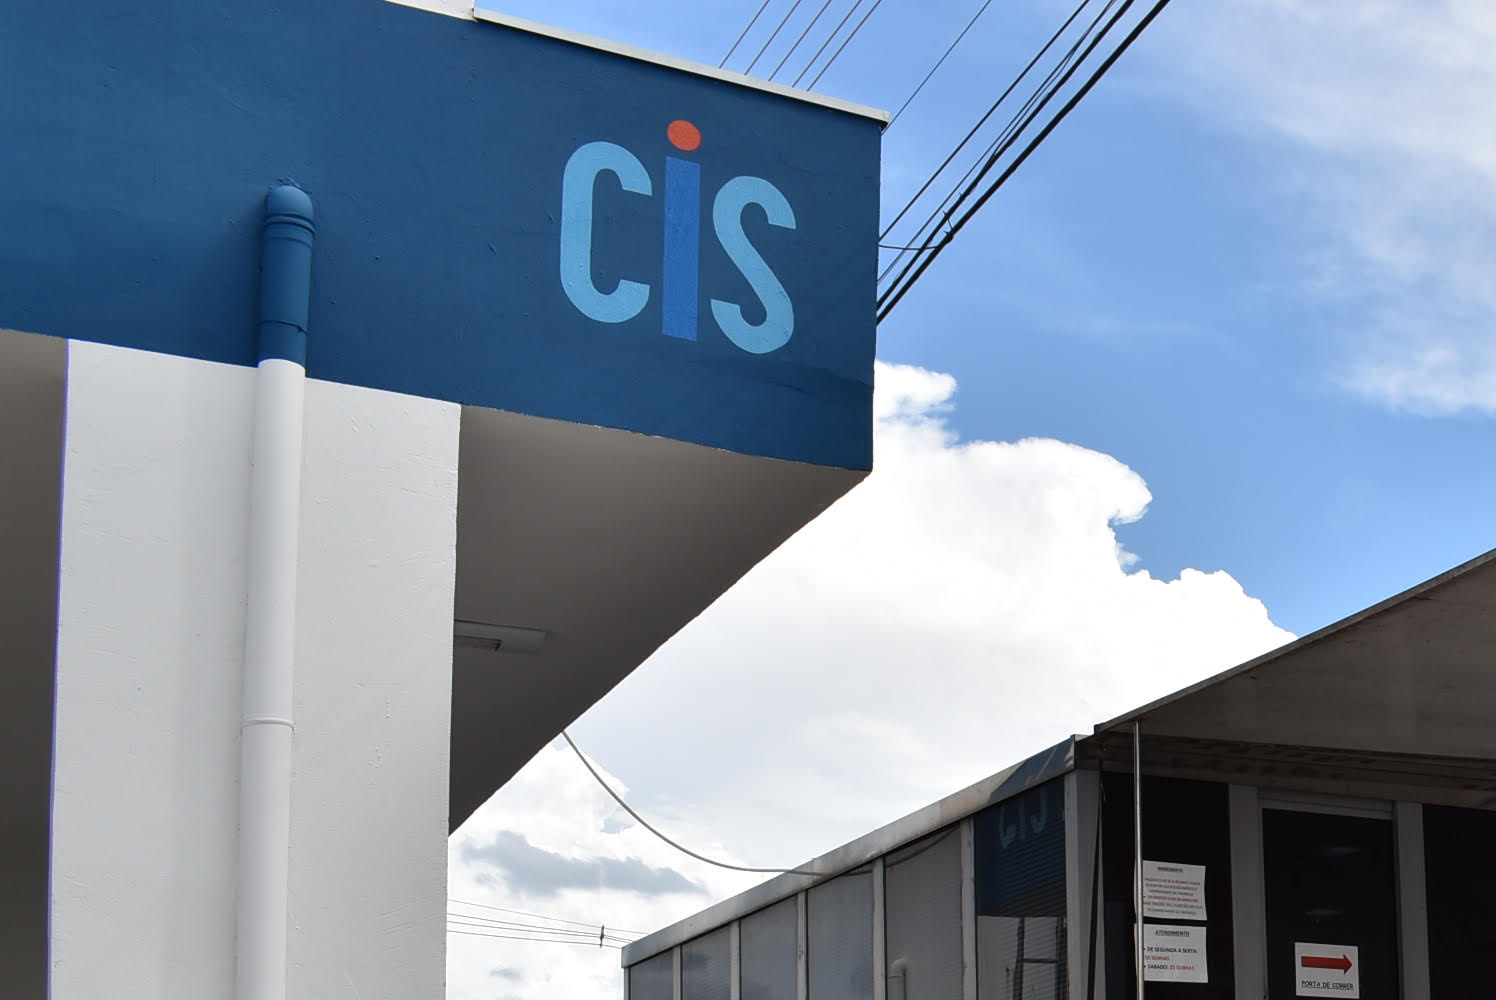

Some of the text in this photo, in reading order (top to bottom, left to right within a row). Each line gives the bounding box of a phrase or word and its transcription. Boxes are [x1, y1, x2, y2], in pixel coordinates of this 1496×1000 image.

[1301, 979, 1354, 991] PORTA DE CORRER
